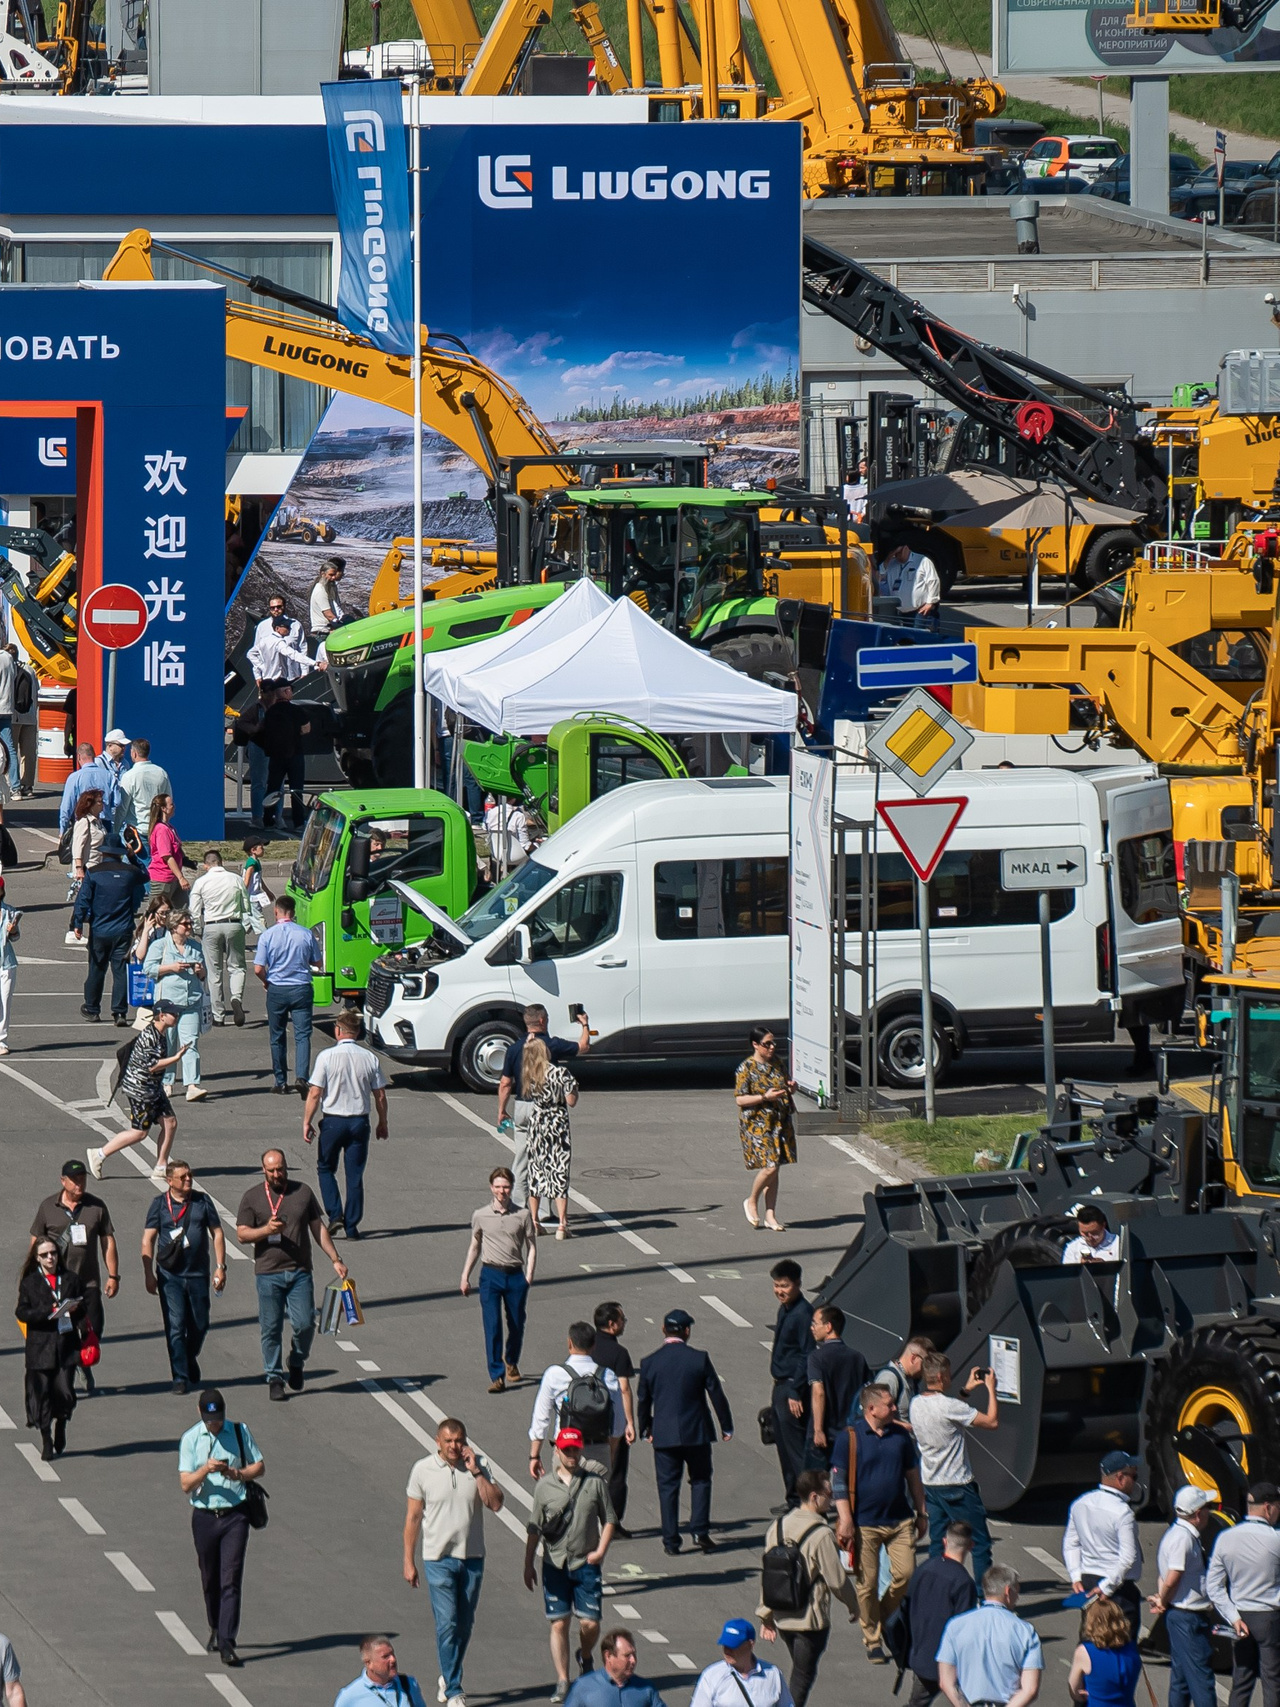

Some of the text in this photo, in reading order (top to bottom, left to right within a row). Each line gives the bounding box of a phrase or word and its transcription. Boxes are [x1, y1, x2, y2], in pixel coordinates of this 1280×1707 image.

[1099, 39, 1168, 49] МЕРОПРИЯТИЙ
[143, 449, 188, 687] 欢迎光临
[1011, 862, 1051, 875] МКАД
